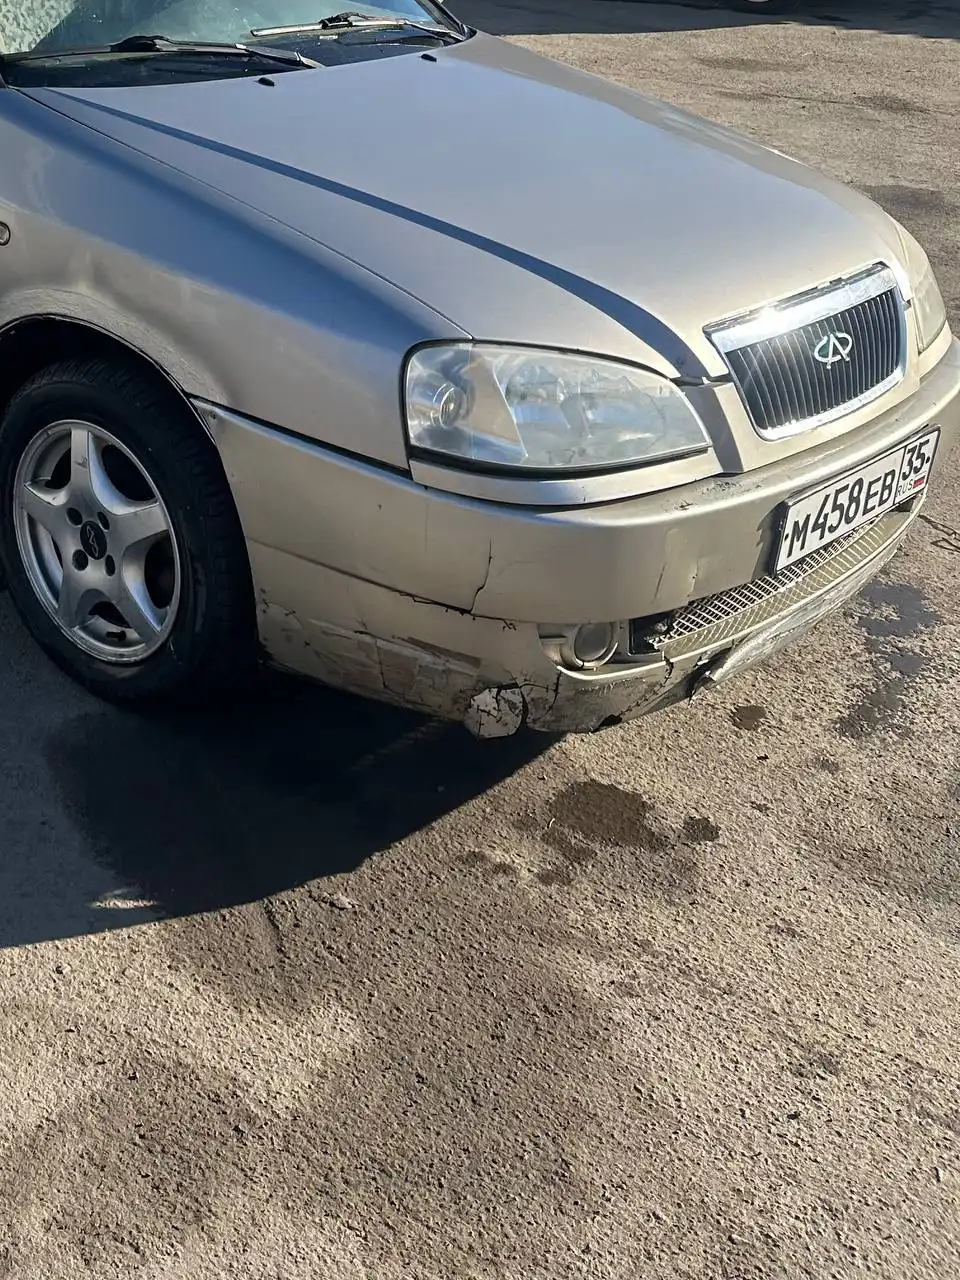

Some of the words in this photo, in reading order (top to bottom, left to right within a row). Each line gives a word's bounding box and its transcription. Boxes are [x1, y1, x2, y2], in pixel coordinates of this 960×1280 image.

[787, 469, 896, 558] М458ЕВ
[901, 439, 930, 481] 35
[896, 478, 913, 497] RUS
